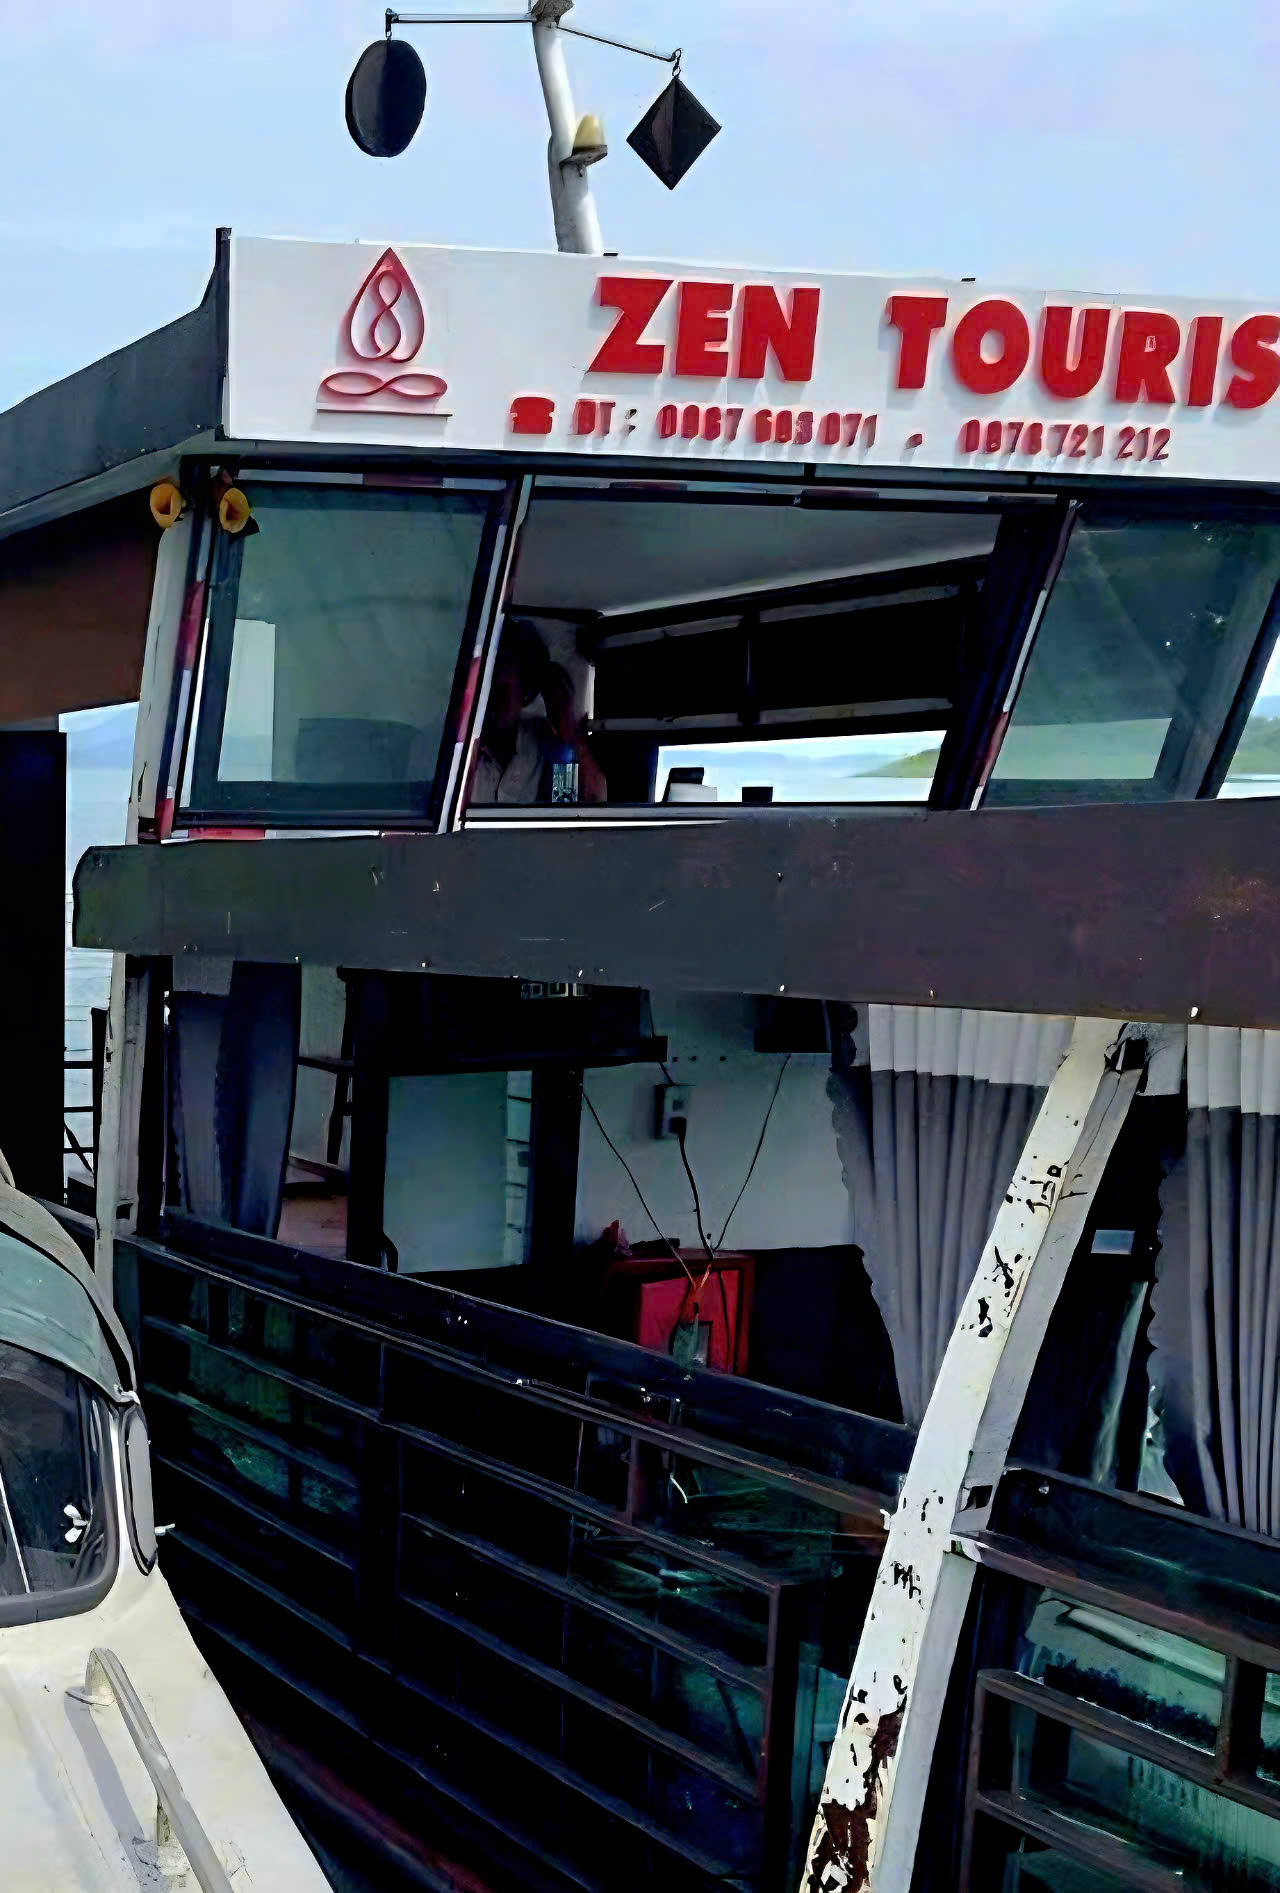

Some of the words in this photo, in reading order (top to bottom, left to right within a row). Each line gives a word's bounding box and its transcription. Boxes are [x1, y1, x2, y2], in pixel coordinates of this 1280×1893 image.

[587, 276, 820, 382] ZEN
[886, 294, 1280, 409] TOURIS
[1114, 426, 1171, 462] 212
